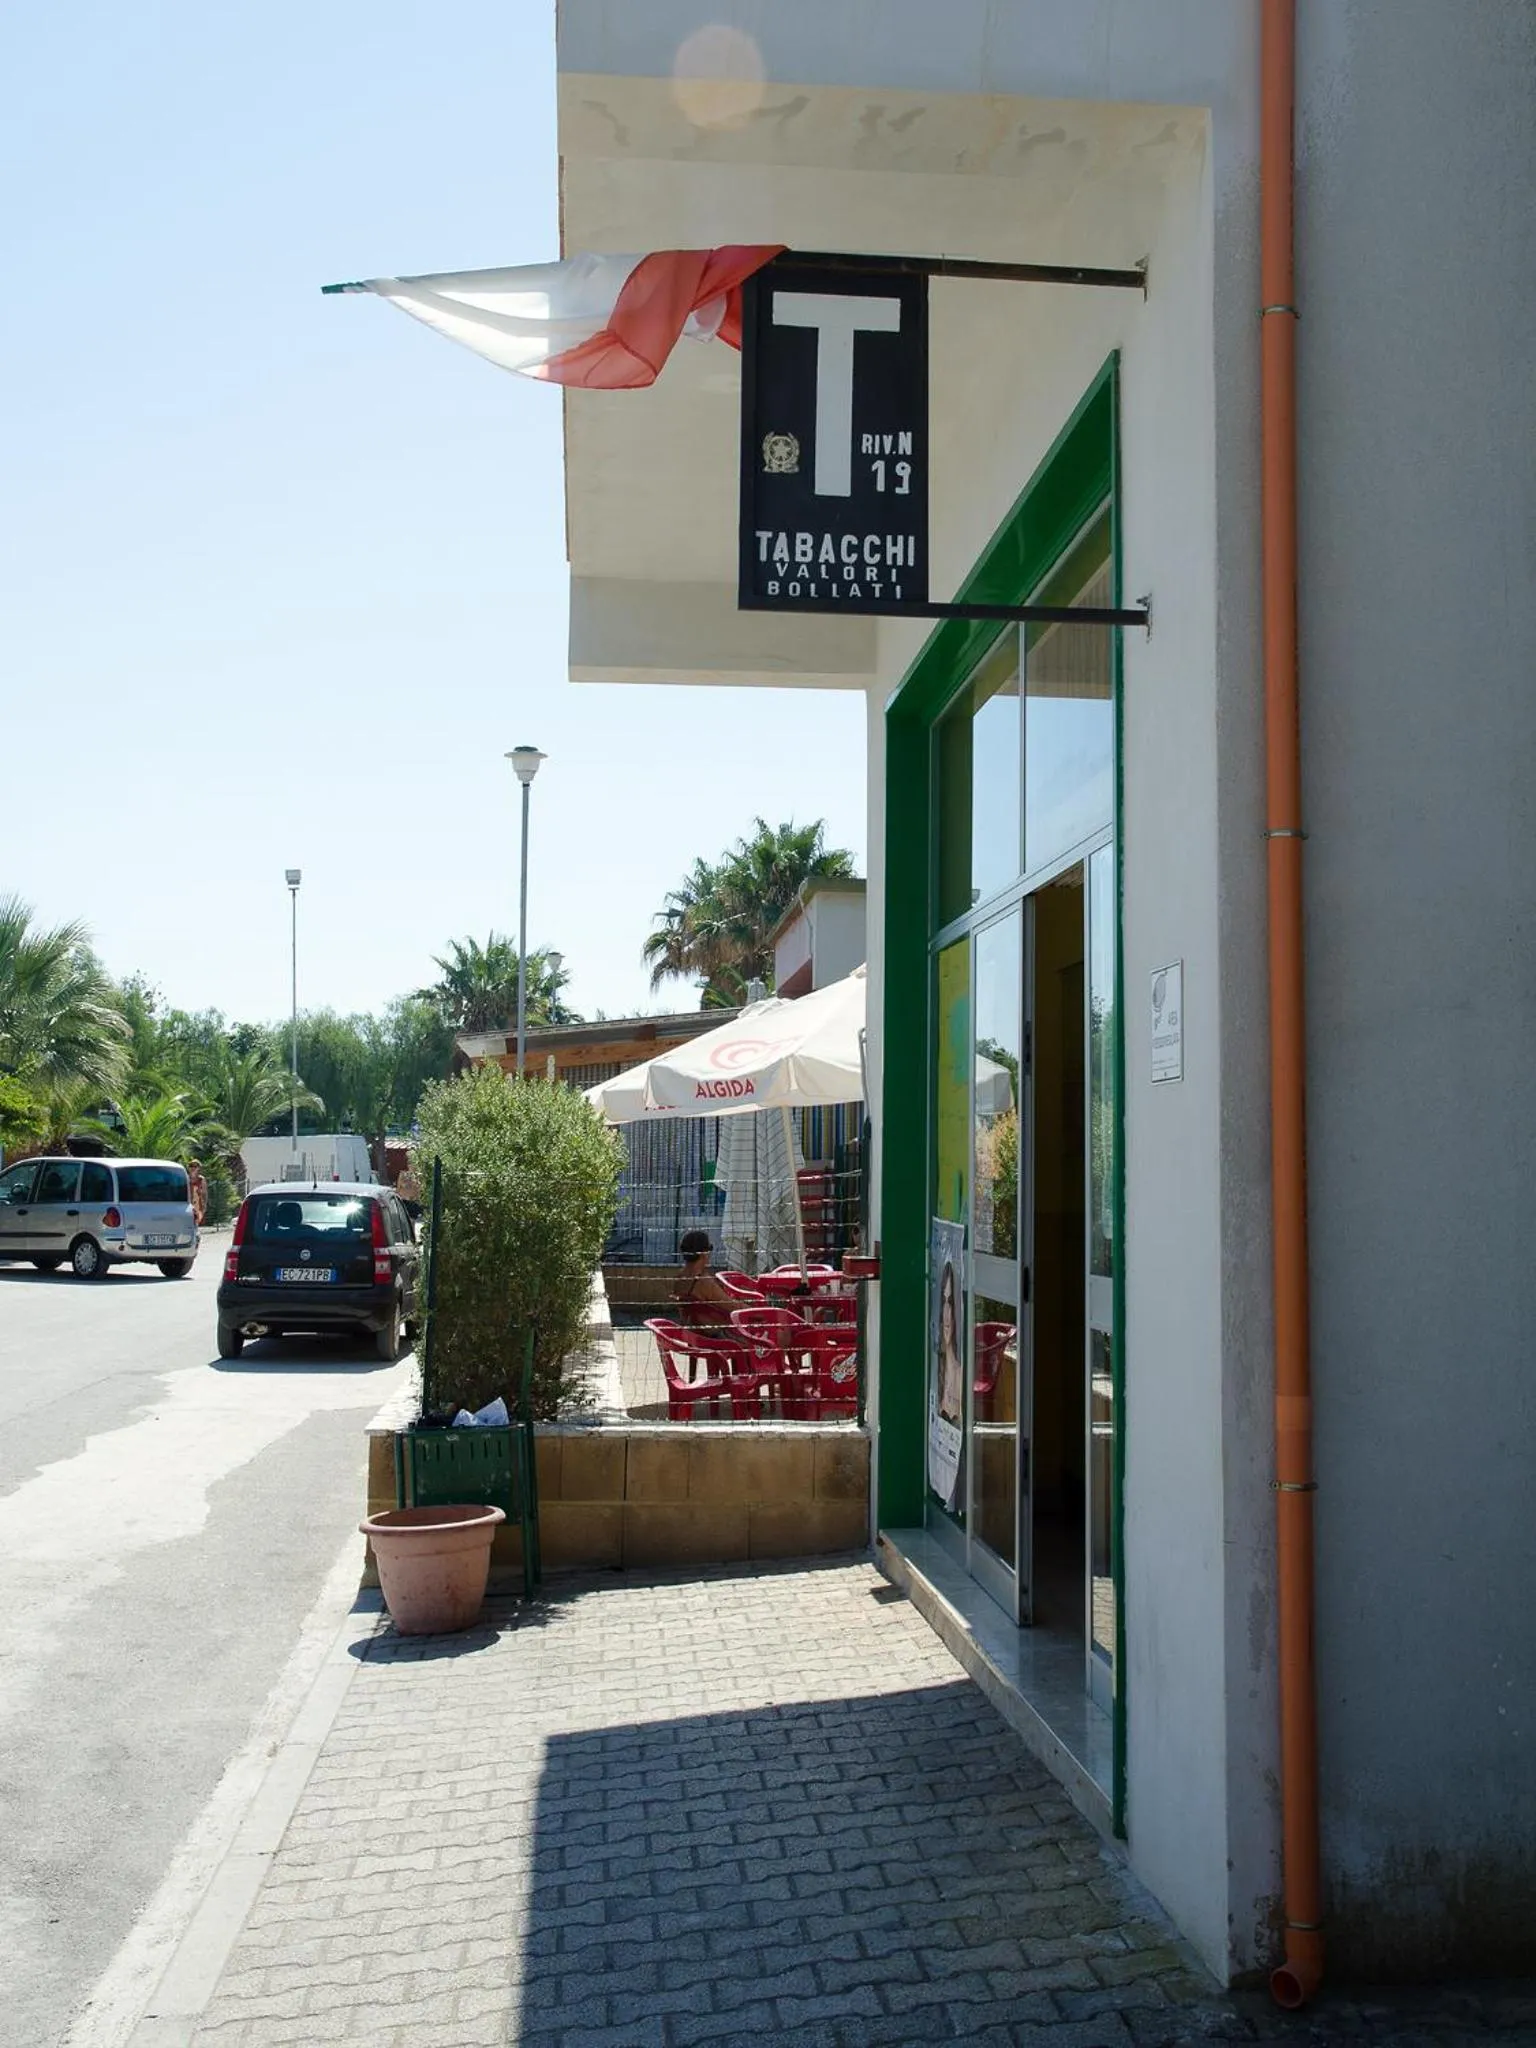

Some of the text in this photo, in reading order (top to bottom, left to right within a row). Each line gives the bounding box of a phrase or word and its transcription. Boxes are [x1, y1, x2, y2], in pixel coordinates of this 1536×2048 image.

[771, 291, 902, 498] T
[871, 460, 912, 495] 19
[756, 530, 916, 567] TABACCHI
[776, 562, 897, 583] VALORI
[767, 580, 902, 600] BOLLATI
[695, 1078, 755, 1099] ALGIDA
